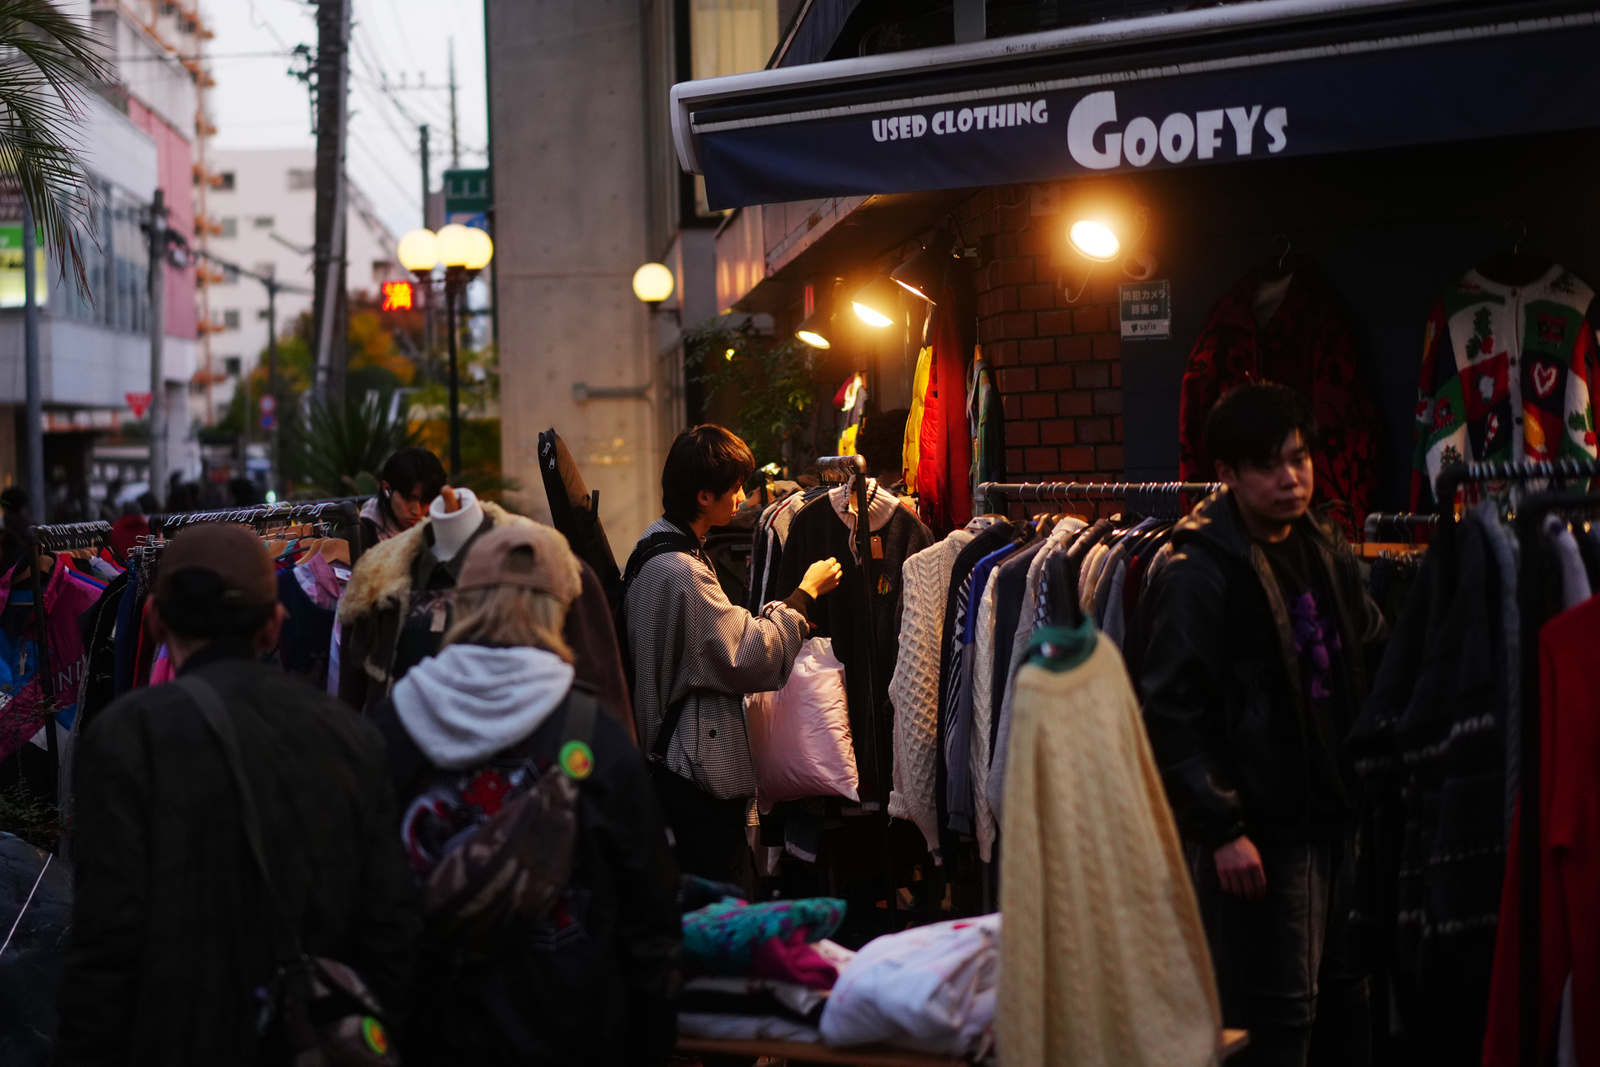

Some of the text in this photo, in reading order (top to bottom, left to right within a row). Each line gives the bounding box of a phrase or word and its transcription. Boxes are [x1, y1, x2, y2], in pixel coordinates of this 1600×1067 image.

[872, 99, 1048, 142] USED CLOTHING
[1122, 290, 1166, 301] 防犯カメラ
[1131, 304, 1159, 315] 録画中
[1139, 322, 1157, 331] safie
